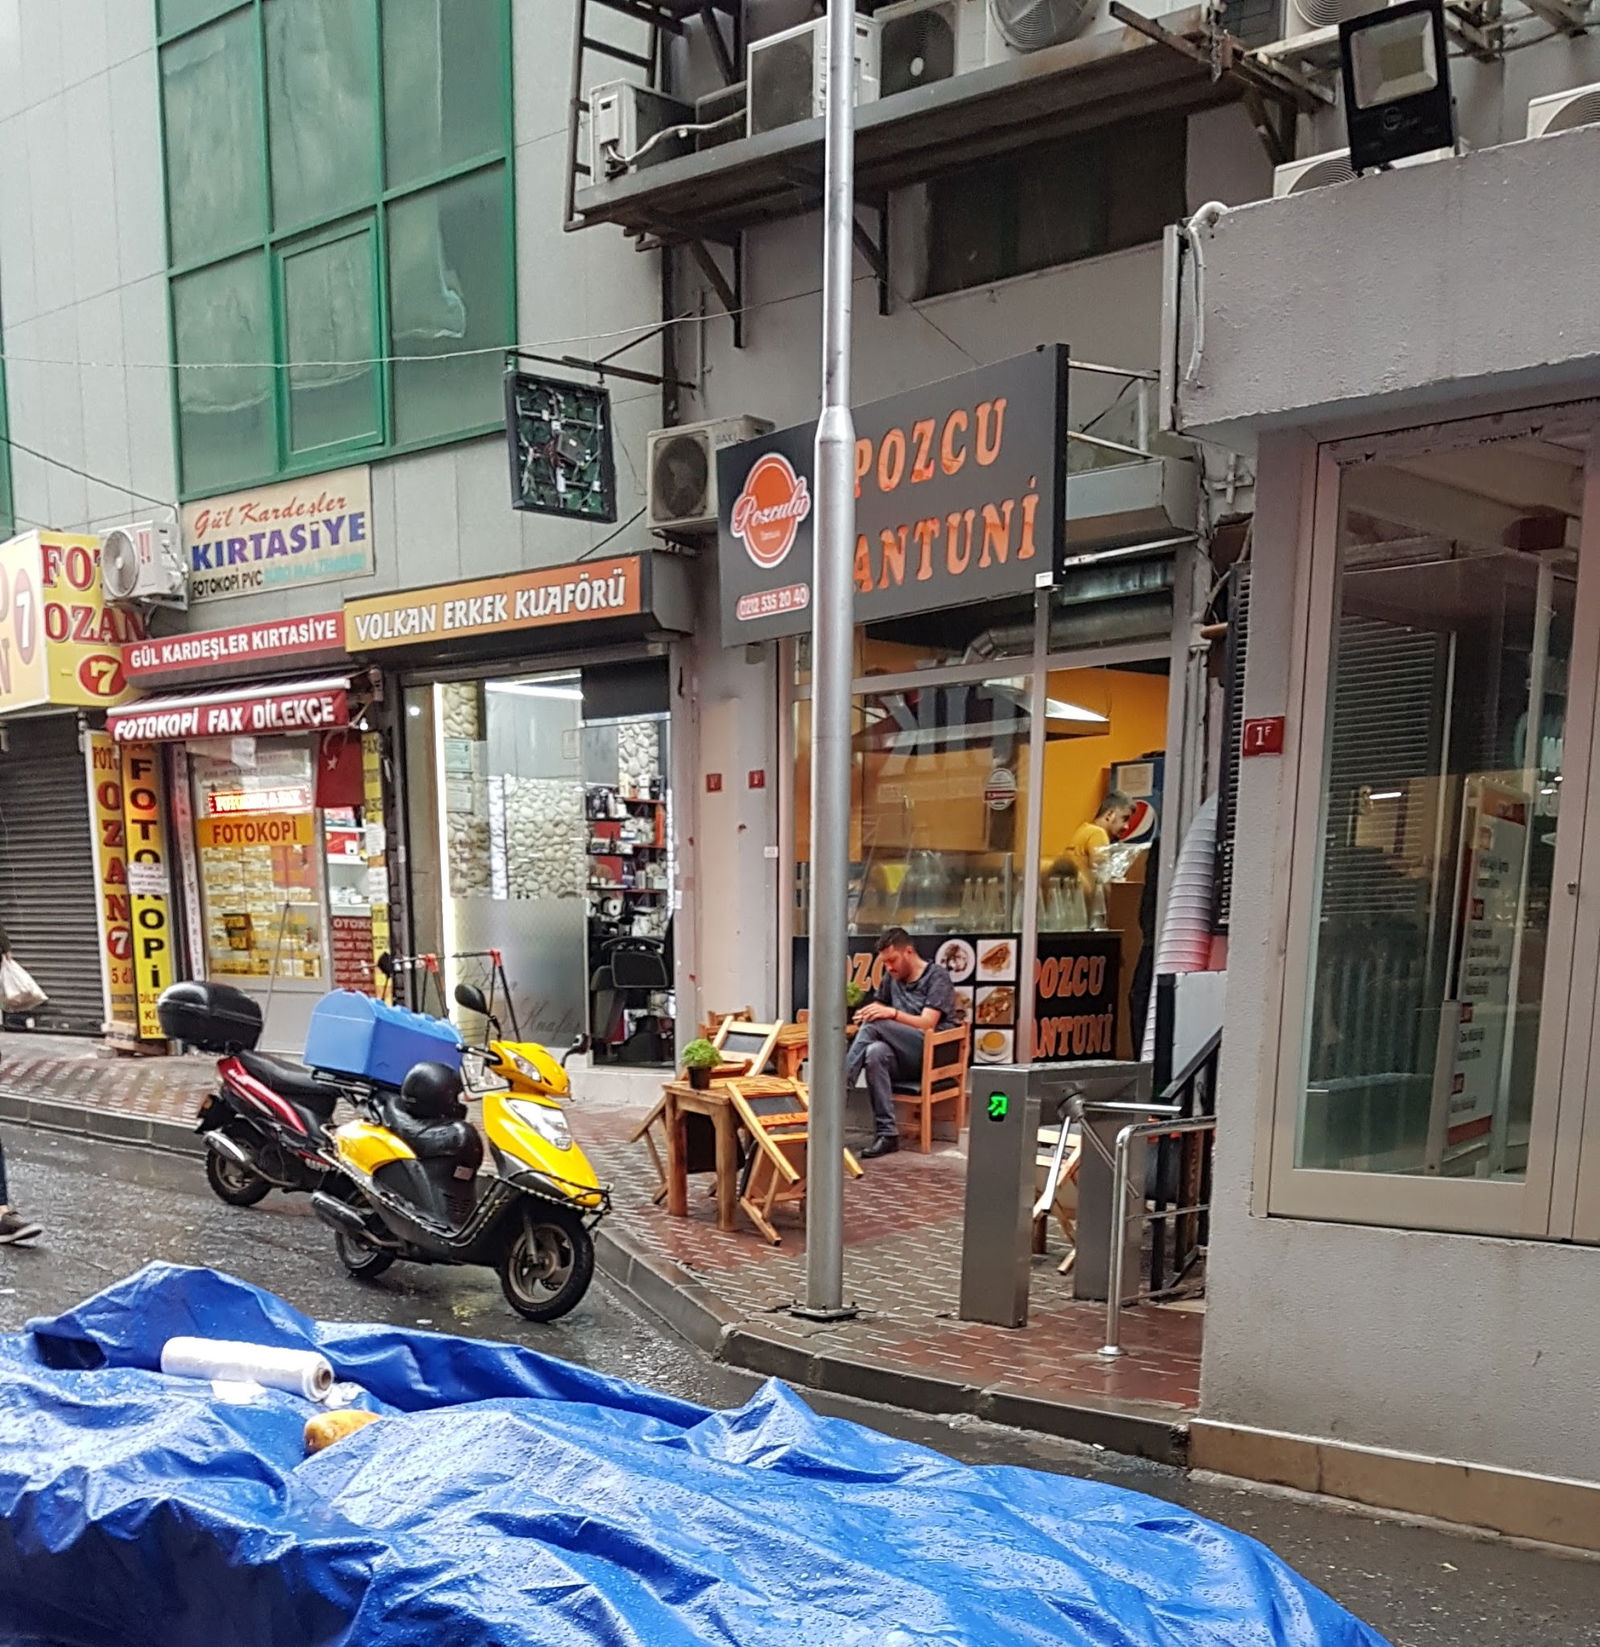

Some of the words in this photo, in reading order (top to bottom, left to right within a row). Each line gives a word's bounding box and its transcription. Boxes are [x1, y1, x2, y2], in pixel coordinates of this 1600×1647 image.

[854, 397, 1008, 499] POZCU
[194, 506, 234, 539] Gül
[854, 475, 1040, 593] ANTUNİ
[242, 570, 264, 587] PVC
[354, 603, 437, 642] VOLKAN
[443, 594, 509, 630] ERKEK
[514, 568, 627, 621] KUAFÖRÜ
[131, 643, 160, 668] GÜL
[162, 631, 249, 662] KARDEŞLER
[251, 615, 338, 651] KIRTASİYE
[90, 660, 119, 694] 7
[113, 704, 200, 742] FOTOKOPİ
[208, 705, 243, 734] FAX
[252, 696, 336, 727] DİLEKÇE
[212, 816, 298, 844] FOTOKOPİ
[130, 758, 165, 988] FOTOOPİ
[111, 930, 129, 955] 7
